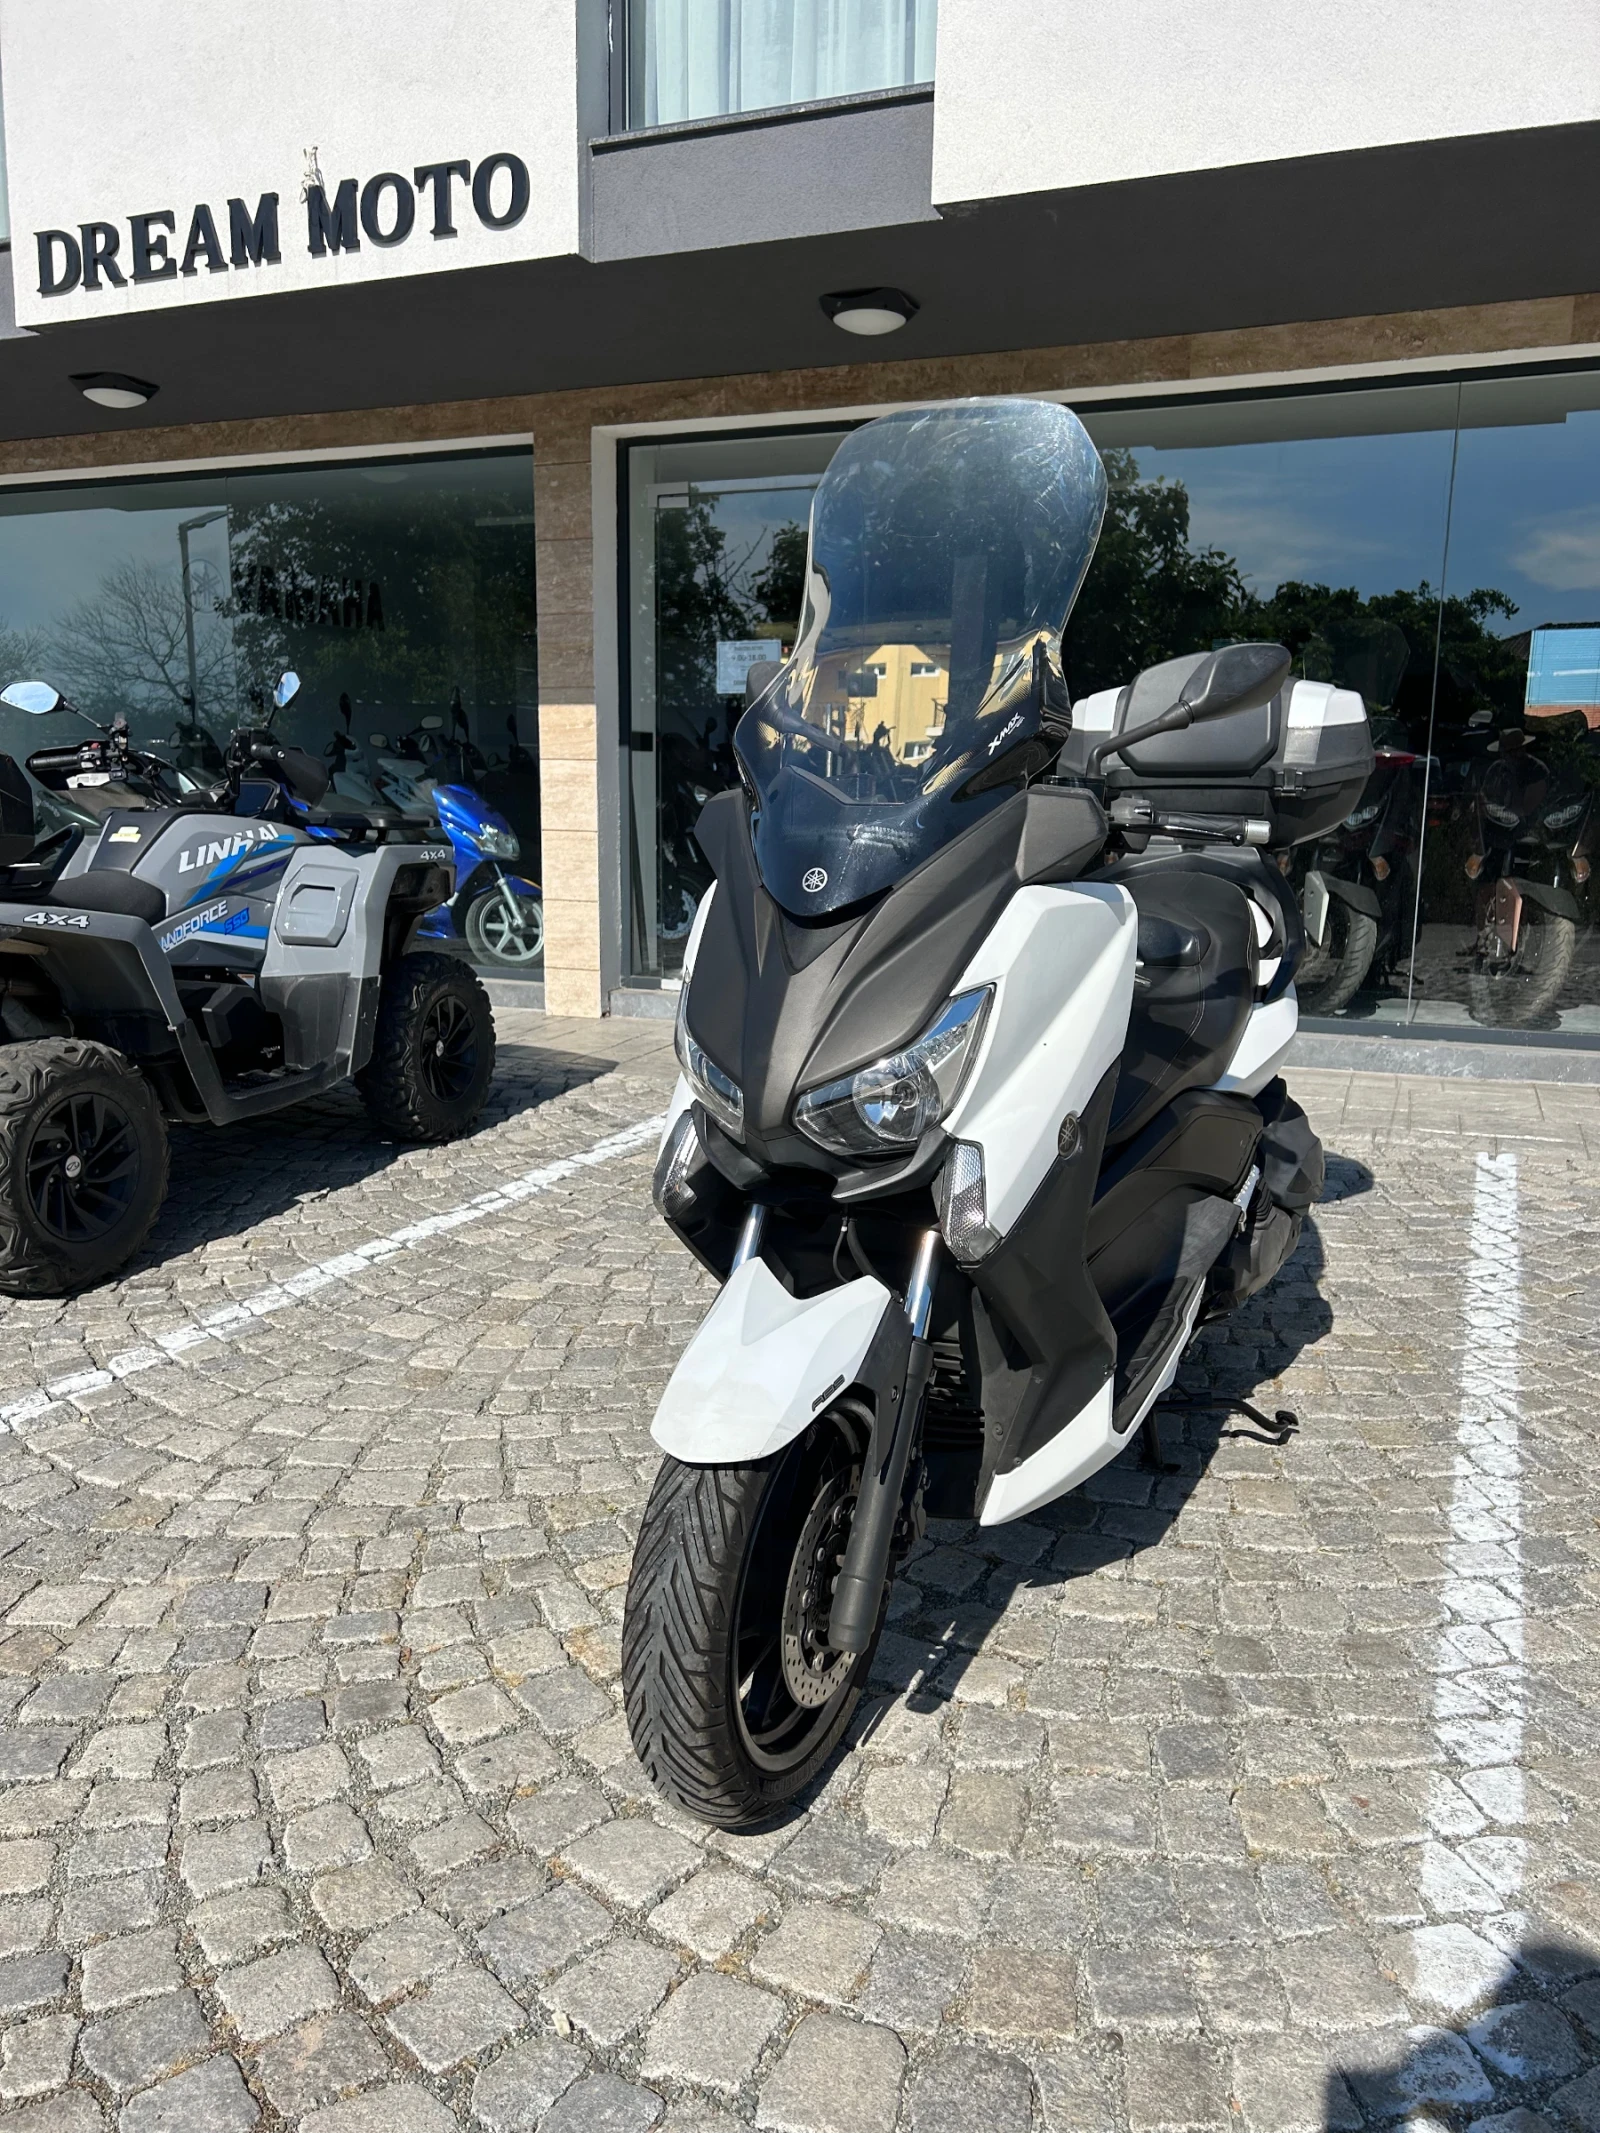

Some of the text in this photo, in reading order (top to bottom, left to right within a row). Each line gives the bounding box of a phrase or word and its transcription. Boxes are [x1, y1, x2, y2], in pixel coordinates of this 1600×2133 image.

[33, 152, 531, 296] DREAM MOTO
[179, 824, 279, 873] LINHAI
[224, 907, 250, 935] 550
[811, 1373, 846, 1413] ABS
